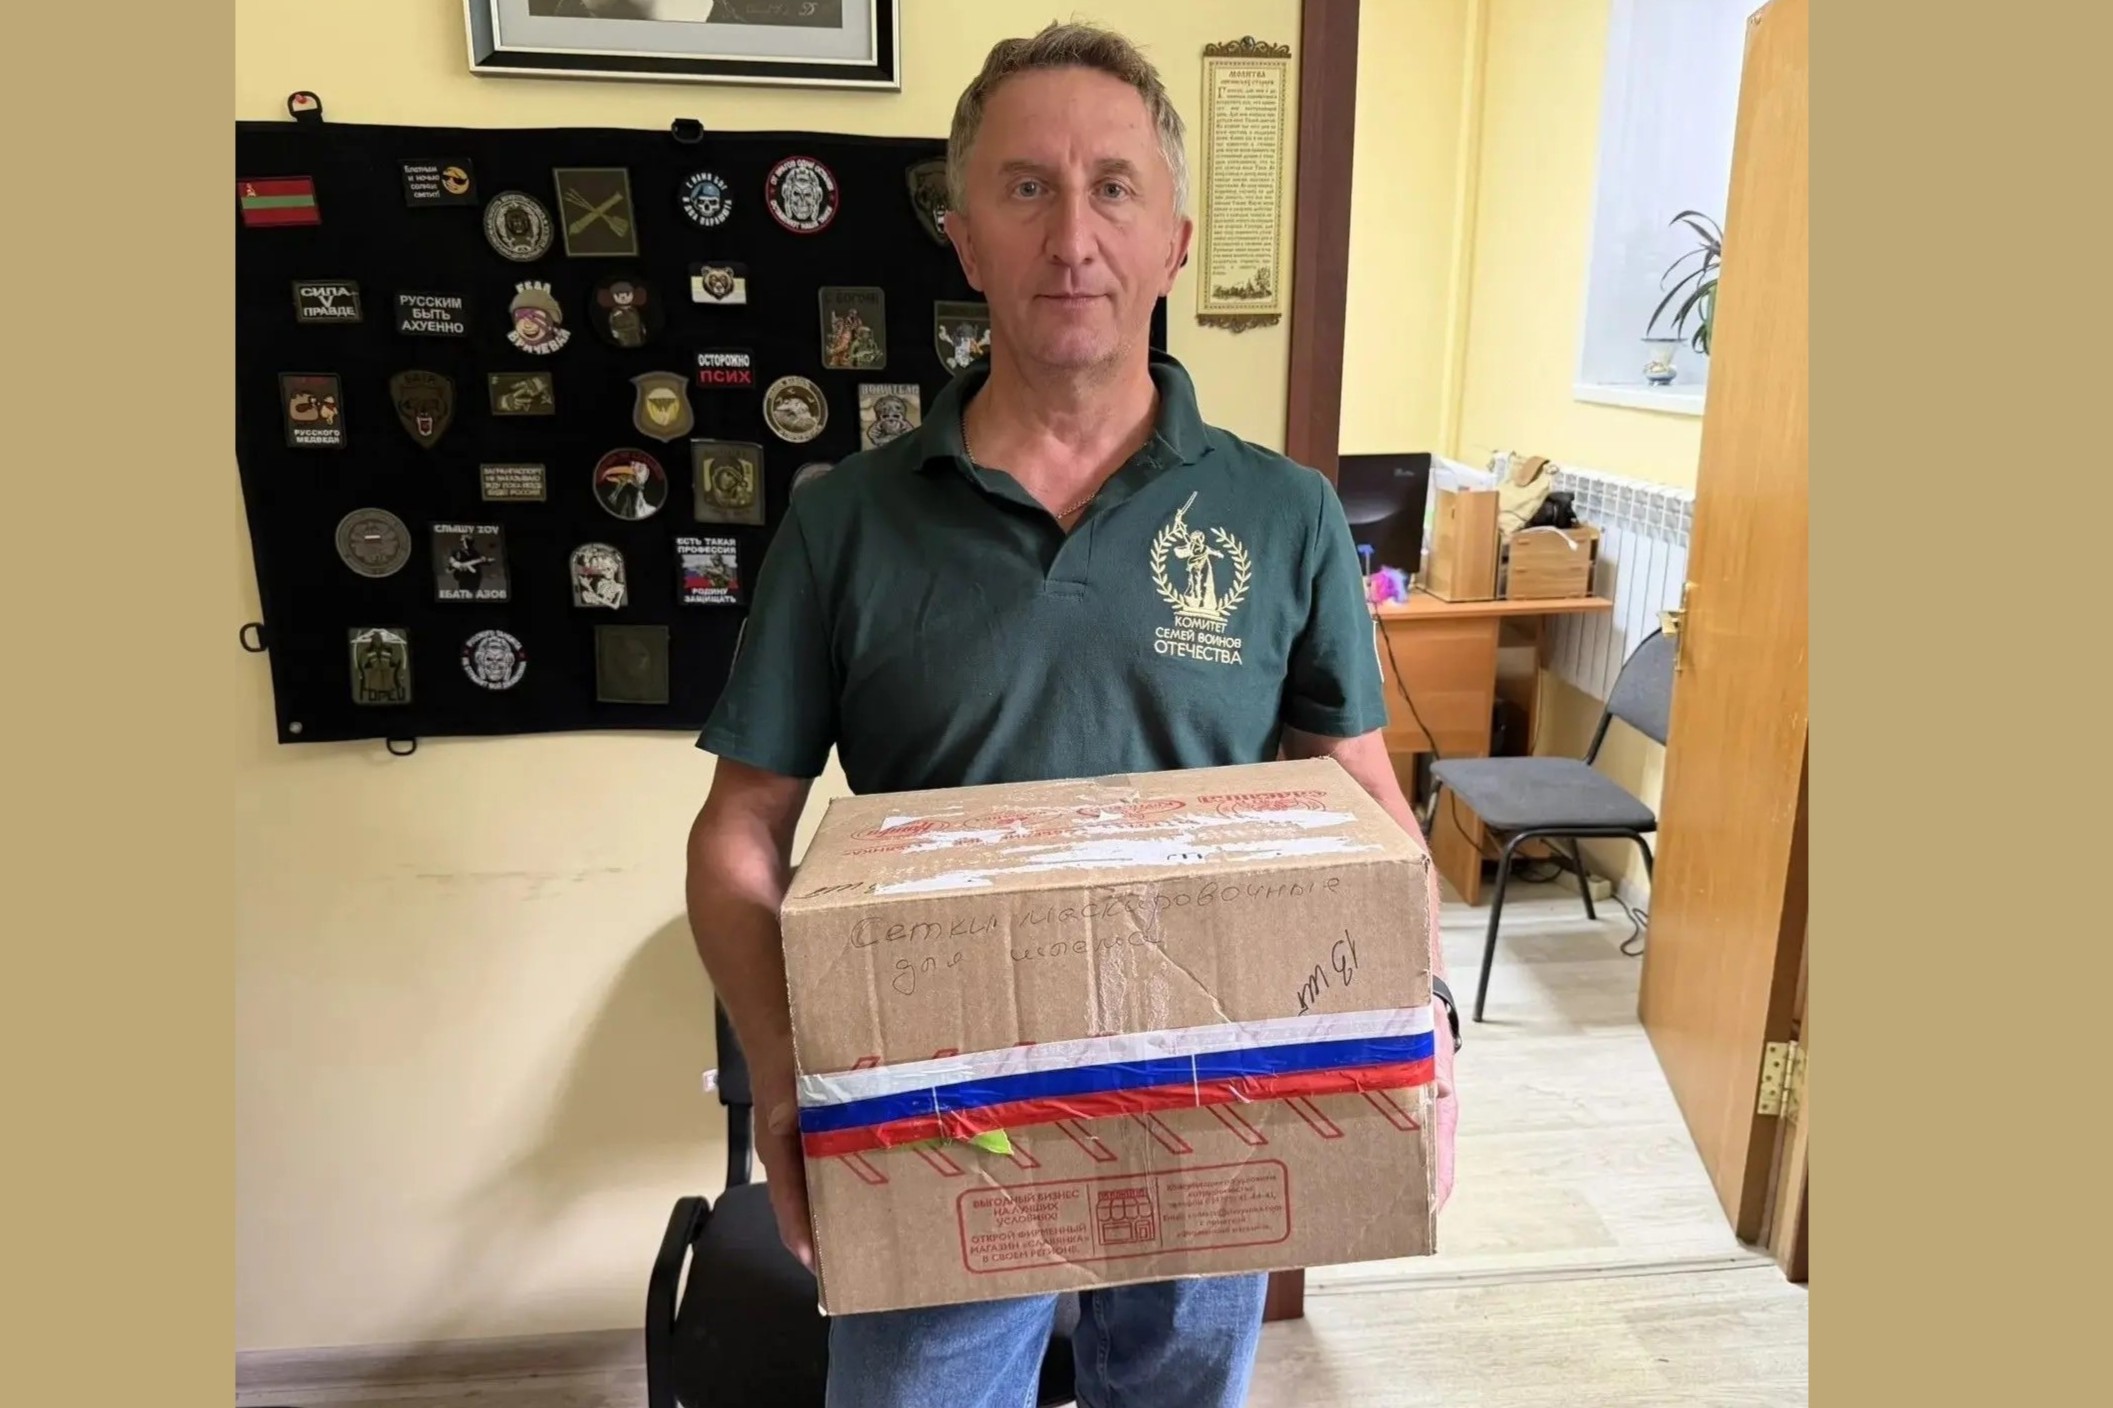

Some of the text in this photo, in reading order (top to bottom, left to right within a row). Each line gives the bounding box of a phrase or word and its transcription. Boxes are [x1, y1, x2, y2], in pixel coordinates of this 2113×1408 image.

[300, 287, 352, 297] СИЛА
[399, 294, 462, 309] РУССКИМ
[303, 306, 356, 317] ПРАВДЕ
[412, 308, 451, 321] БЫТЬ
[402, 320, 464, 333] АХУЕННО
[698, 353, 750, 367] ОСТОРОЖНО
[700, 370, 752, 384] ПСИХ
[434, 524, 474, 533] СЛЫШУ
[704, 538, 736, 546] ТАКАЯ
[677, 546, 736, 554] ПРОФЕССИЯ
[439, 589, 507, 599] ЕБАТЬ АЗОВ
[684, 595, 736, 603] ЗАЩИЩАТЬ
[1175, 616, 1227, 633] КОМИТЕТ
[1155, 627, 1242, 649] СЕМЕЙ ВОИНОВ
[1154, 640, 1243, 665] ОТЕЧЕСТВА
[851, 916, 997, 948] Сетки
[892, 952, 965, 996] для
[973, 1189, 1079, 1208] ВЫГОДНЫЙ БИЗНЕС
[993, 1203, 1059, 1217] НА ЛУЧШИХ
[971, 1223, 1087, 1244] ОТКРОЙ ФИРМЕННЫЙ
[970, 1242, 1019, 1254] МАГАЗИН
[983, 1254, 989, 1263] В
[991, 1250, 1028, 1262] СВОЕМ
